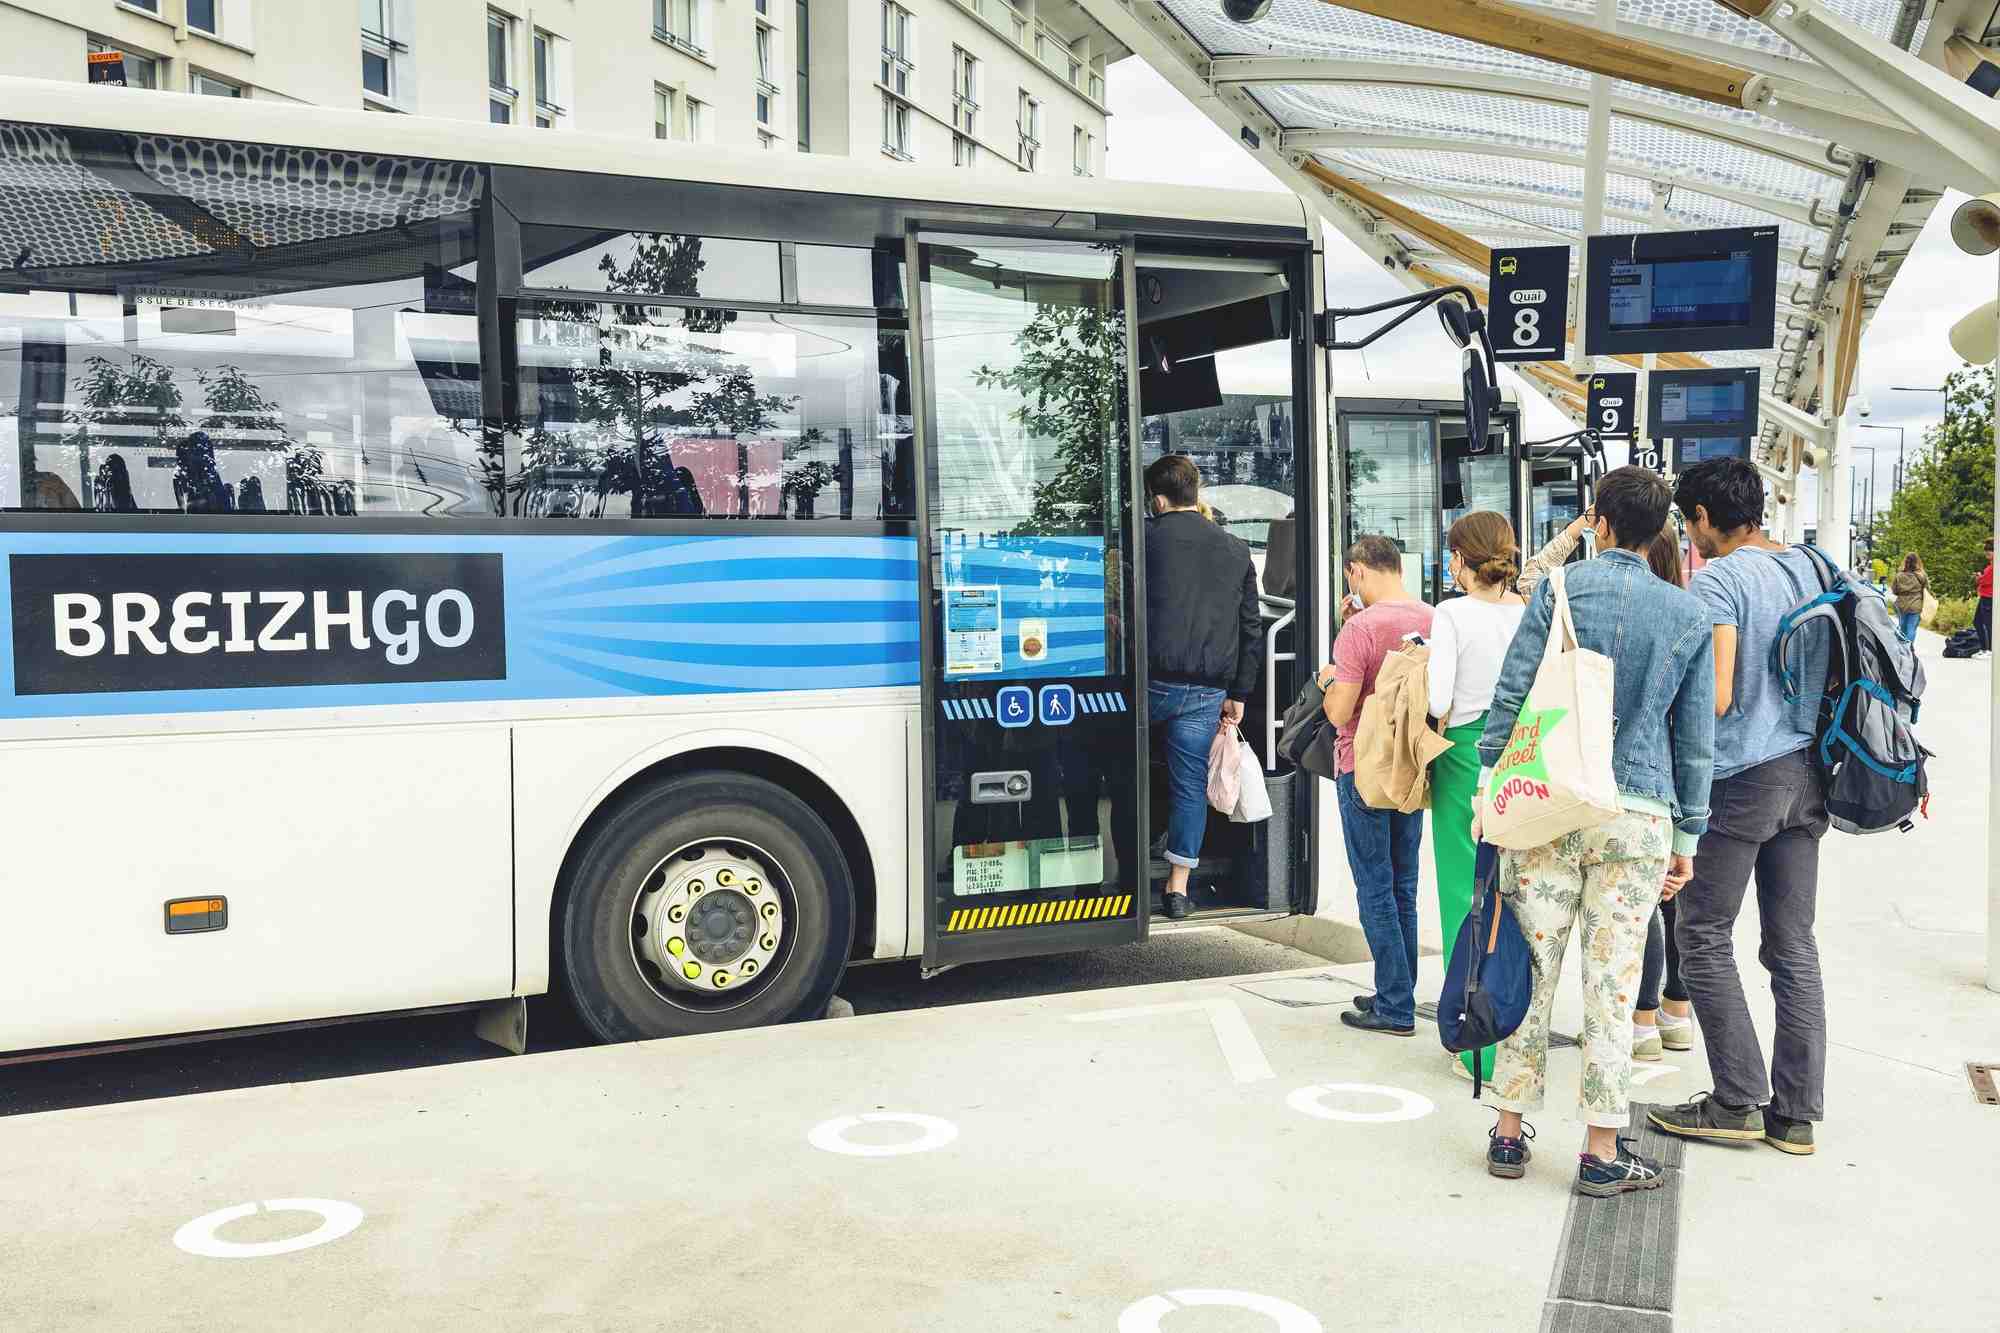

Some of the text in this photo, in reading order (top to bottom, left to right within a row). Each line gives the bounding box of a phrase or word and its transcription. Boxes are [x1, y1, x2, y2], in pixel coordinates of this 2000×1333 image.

[136, 296, 172, 305] SSUE
[178, 299, 194, 307] DE
[1514, 290, 1543, 303] Quai
[1512, 307, 1541, 347] 8
[1601, 398, 1621, 406] Quai
[1602, 408, 1619, 432] 9
[1637, 451, 1659, 469] 10
[1496, 738, 1537, 777] treet
[1493, 778, 1550, 816] LONDON
